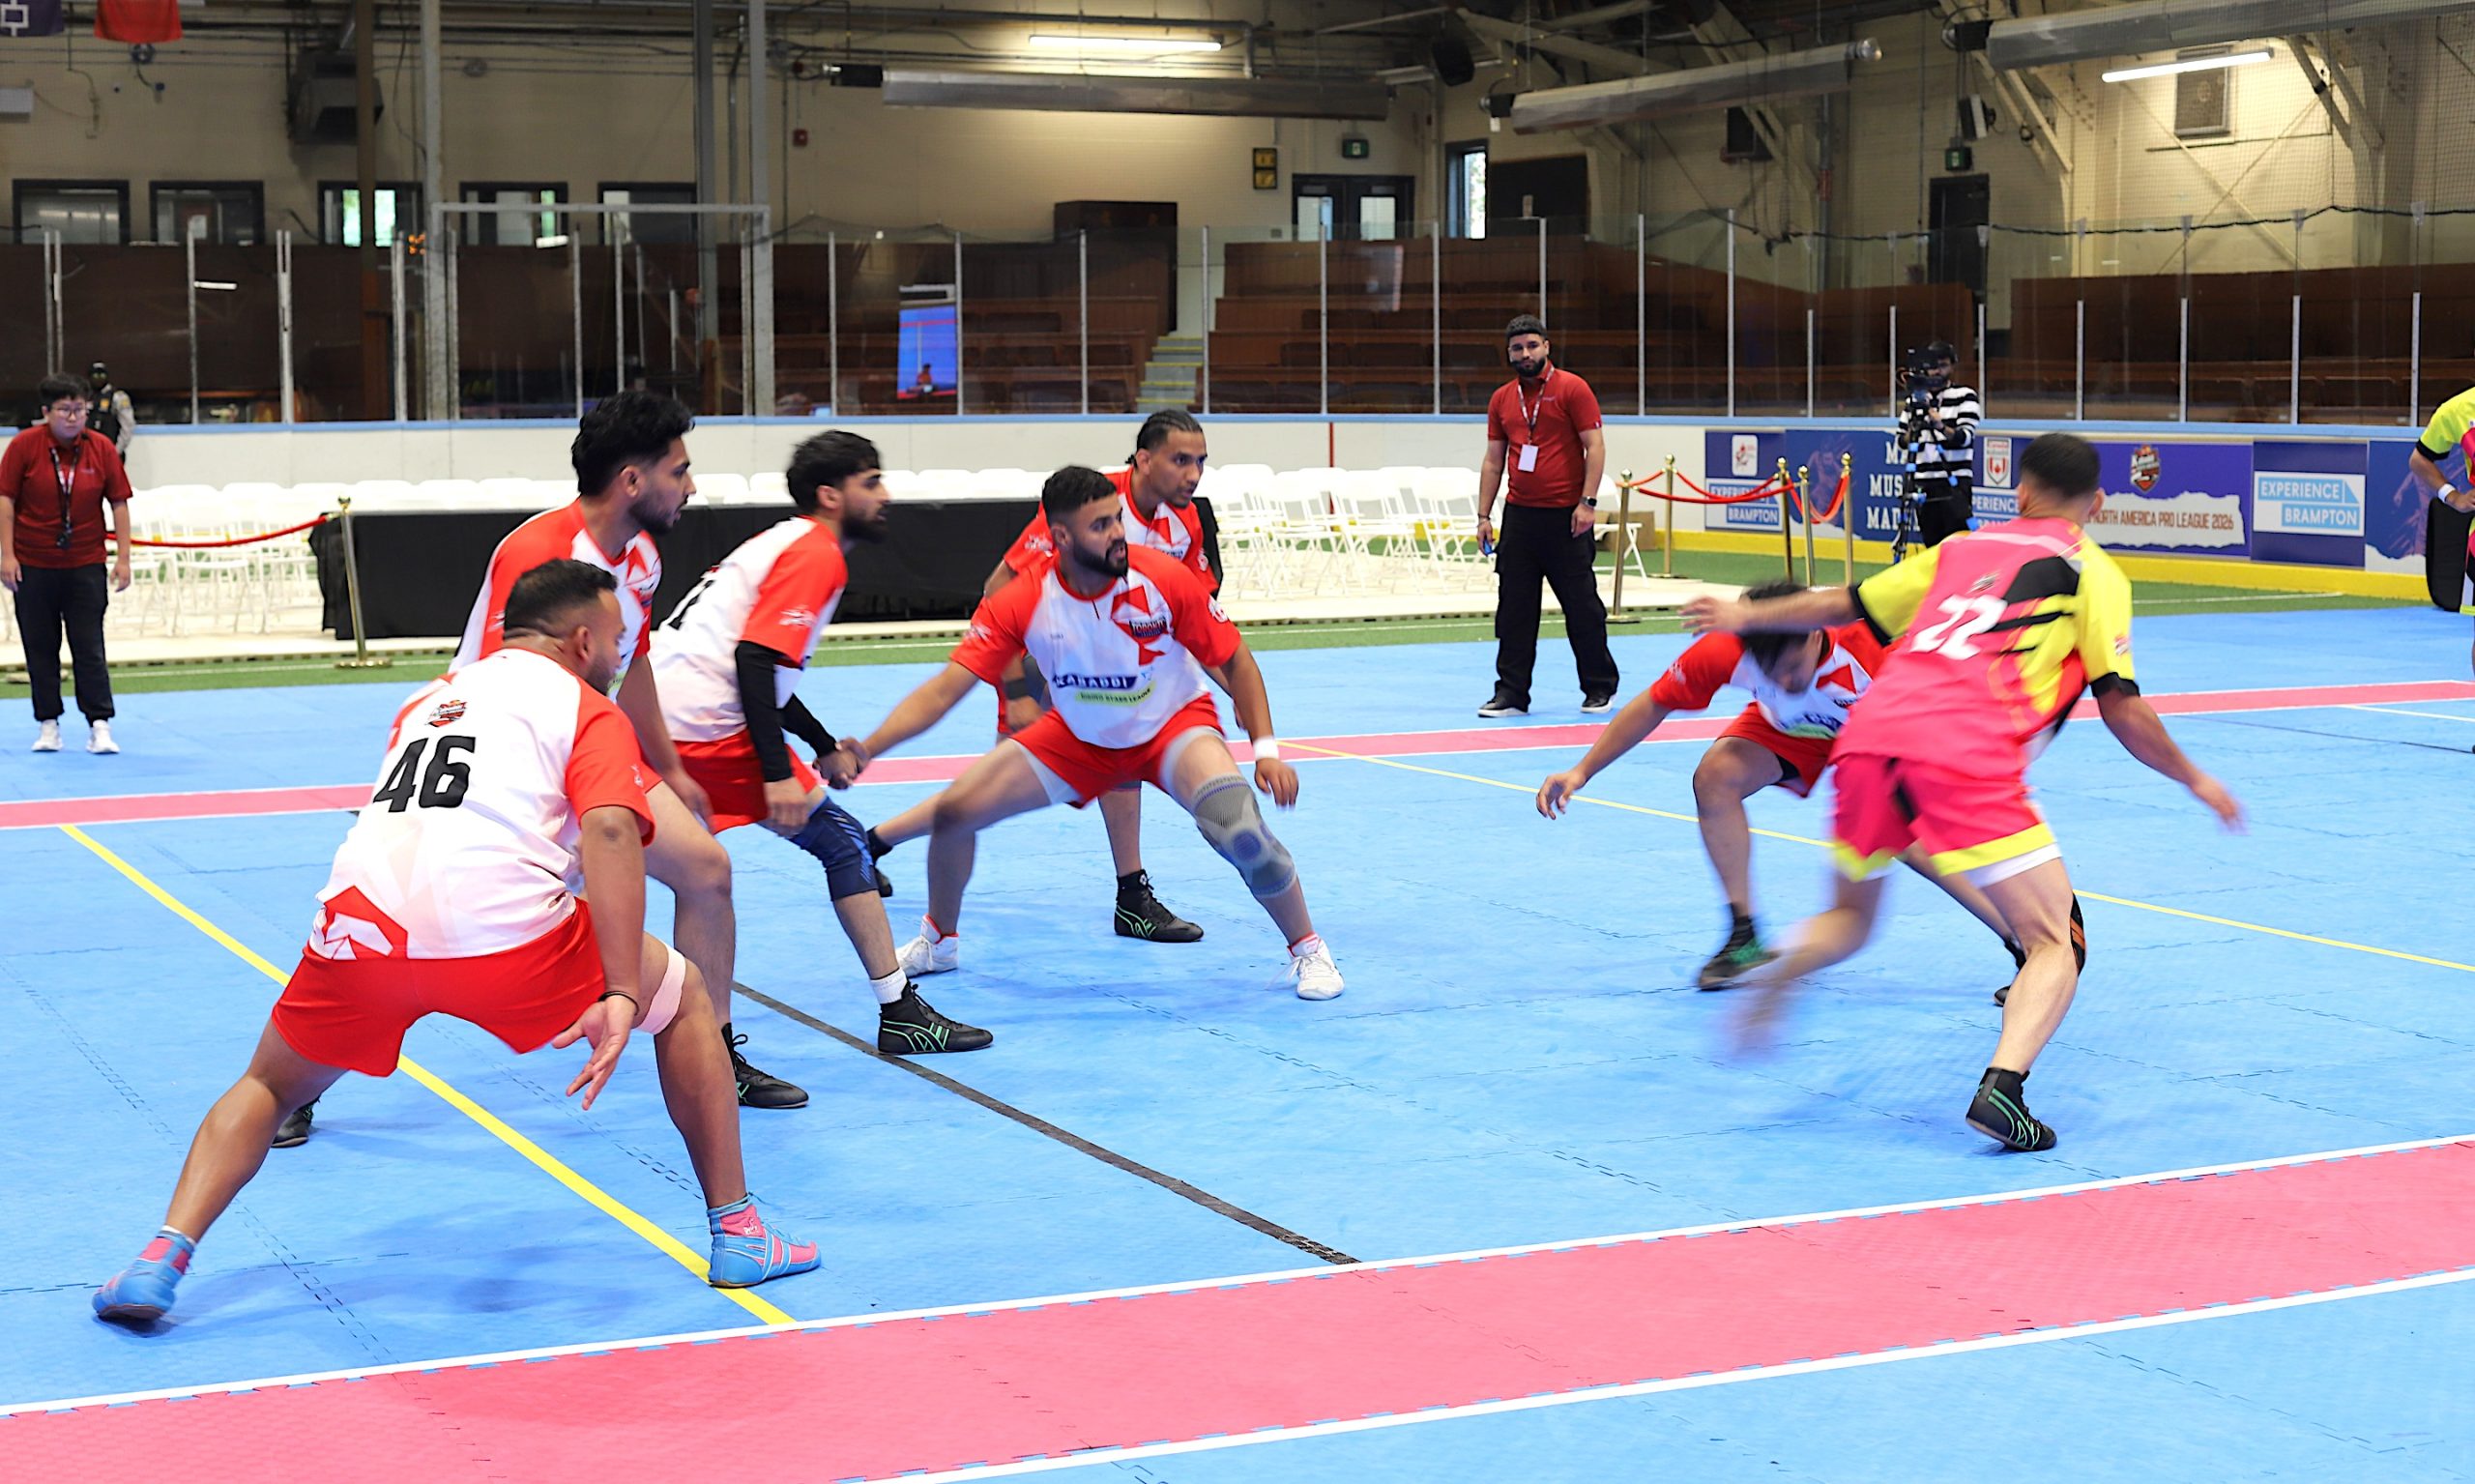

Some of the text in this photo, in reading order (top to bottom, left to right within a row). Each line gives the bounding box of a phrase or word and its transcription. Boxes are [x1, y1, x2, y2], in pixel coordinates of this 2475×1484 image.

[2261, 480, 2340, 499] EXPERIENCE
[1729, 507, 1778, 523] BRAMPTON
[2120, 510, 2157, 527] AMERICA
[2159, 511, 2174, 528] PRO
[2176, 512, 2210, 529] LEAGUE
[2212, 513, 2234, 530] 2026
[2285, 508, 2357, 526] BRAMPTON
[1908, 594, 2008, 660] 22
[373, 735, 476, 812] 46
